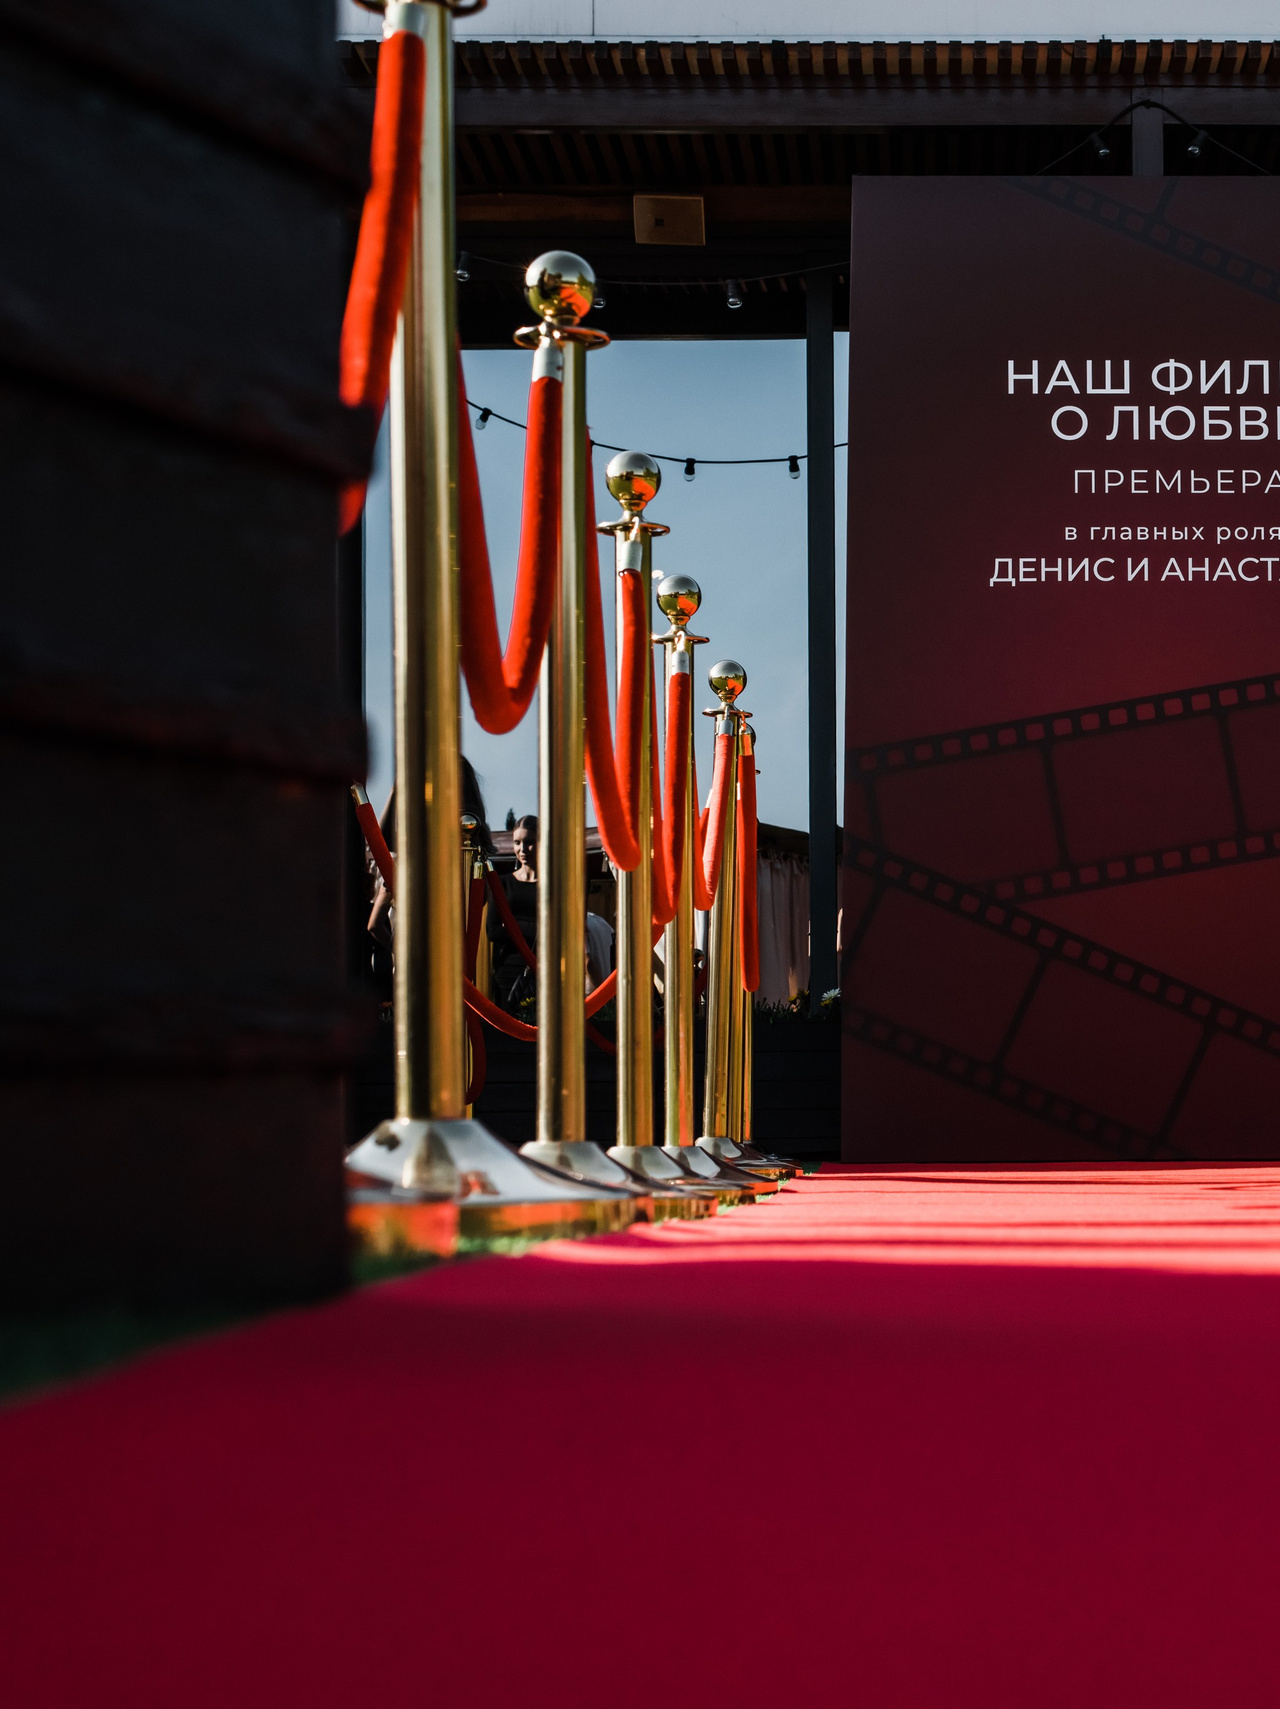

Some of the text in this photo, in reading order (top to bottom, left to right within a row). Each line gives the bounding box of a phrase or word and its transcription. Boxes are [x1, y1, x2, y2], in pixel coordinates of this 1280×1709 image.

[1007, 359, 1130, 395] НАШ
[1051, 405, 1089, 441] О
[1064, 526, 1078, 541] в
[1090, 526, 1204, 541] главных
[989, 557, 1115, 587] ДЕНИС
[1127, 557, 1149, 582] И
